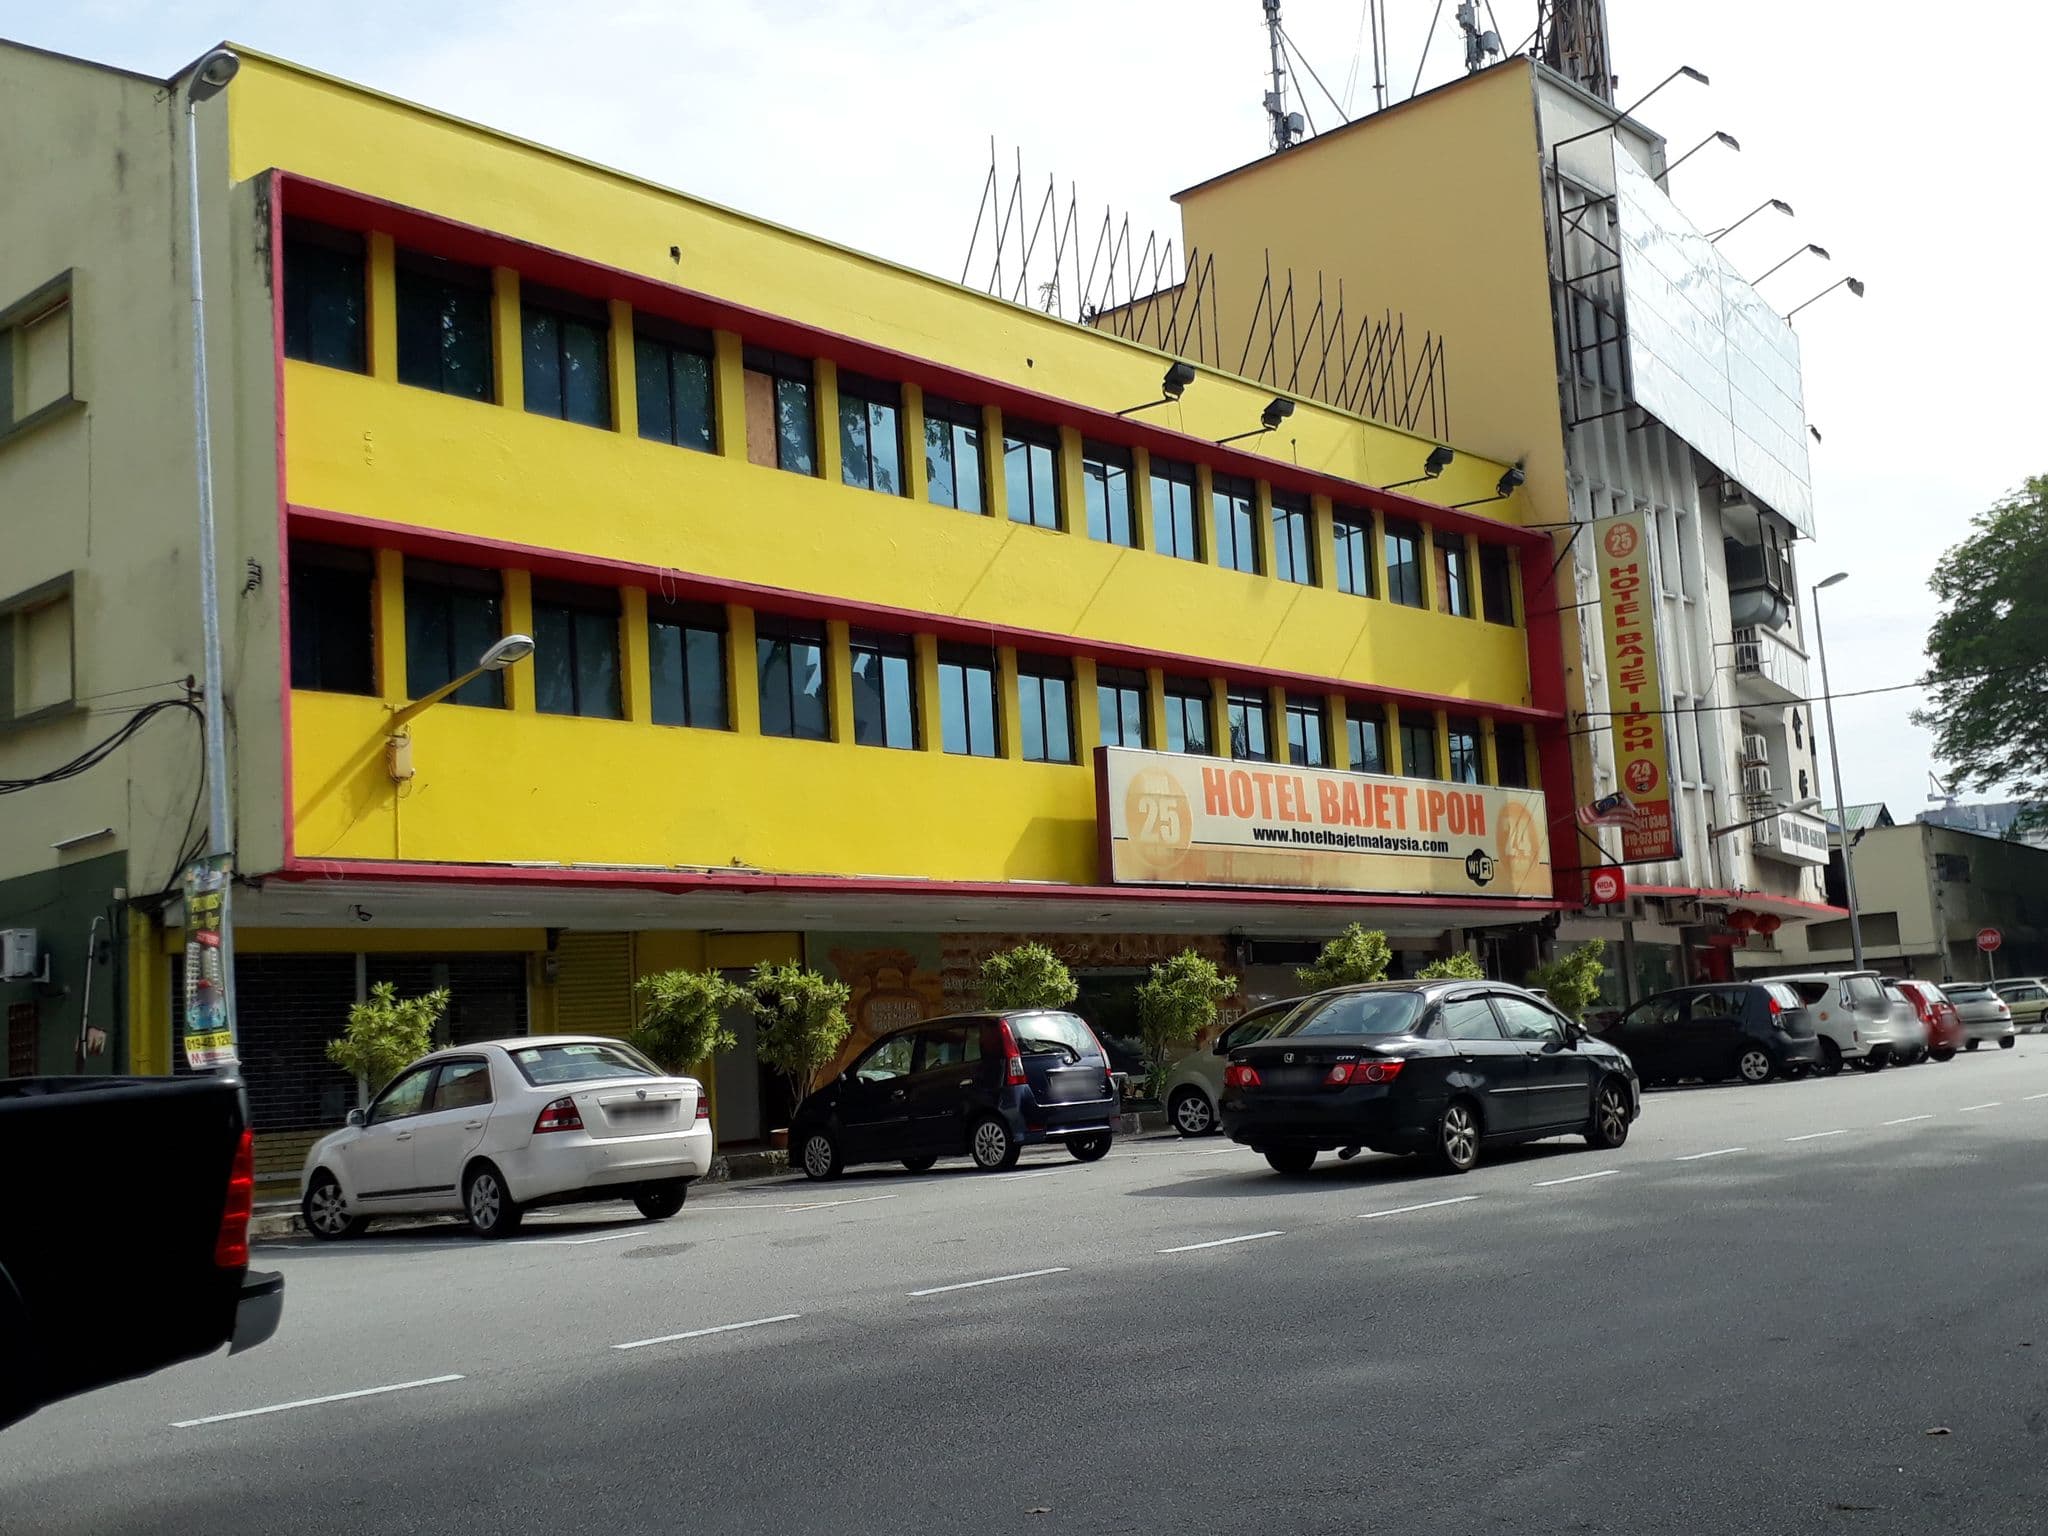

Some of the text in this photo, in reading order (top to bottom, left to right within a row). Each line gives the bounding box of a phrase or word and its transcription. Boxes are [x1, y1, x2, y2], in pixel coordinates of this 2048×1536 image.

[1611, 532, 1632, 551] 25
[1610, 563, 1640, 628] HOTEL
[1616, 632, 1647, 694] BAJET
[1623, 702, 1653, 752] IPOH
[1630, 761, 1651, 778] 24
[1137, 798, 1181, 845] 25
[1204, 767, 1486, 836] HOTEL BAJET IPOH
[1253, 828, 1449, 854] www.hotelbajetmalaysia.com
[1502, 814, 1533, 857] 24
